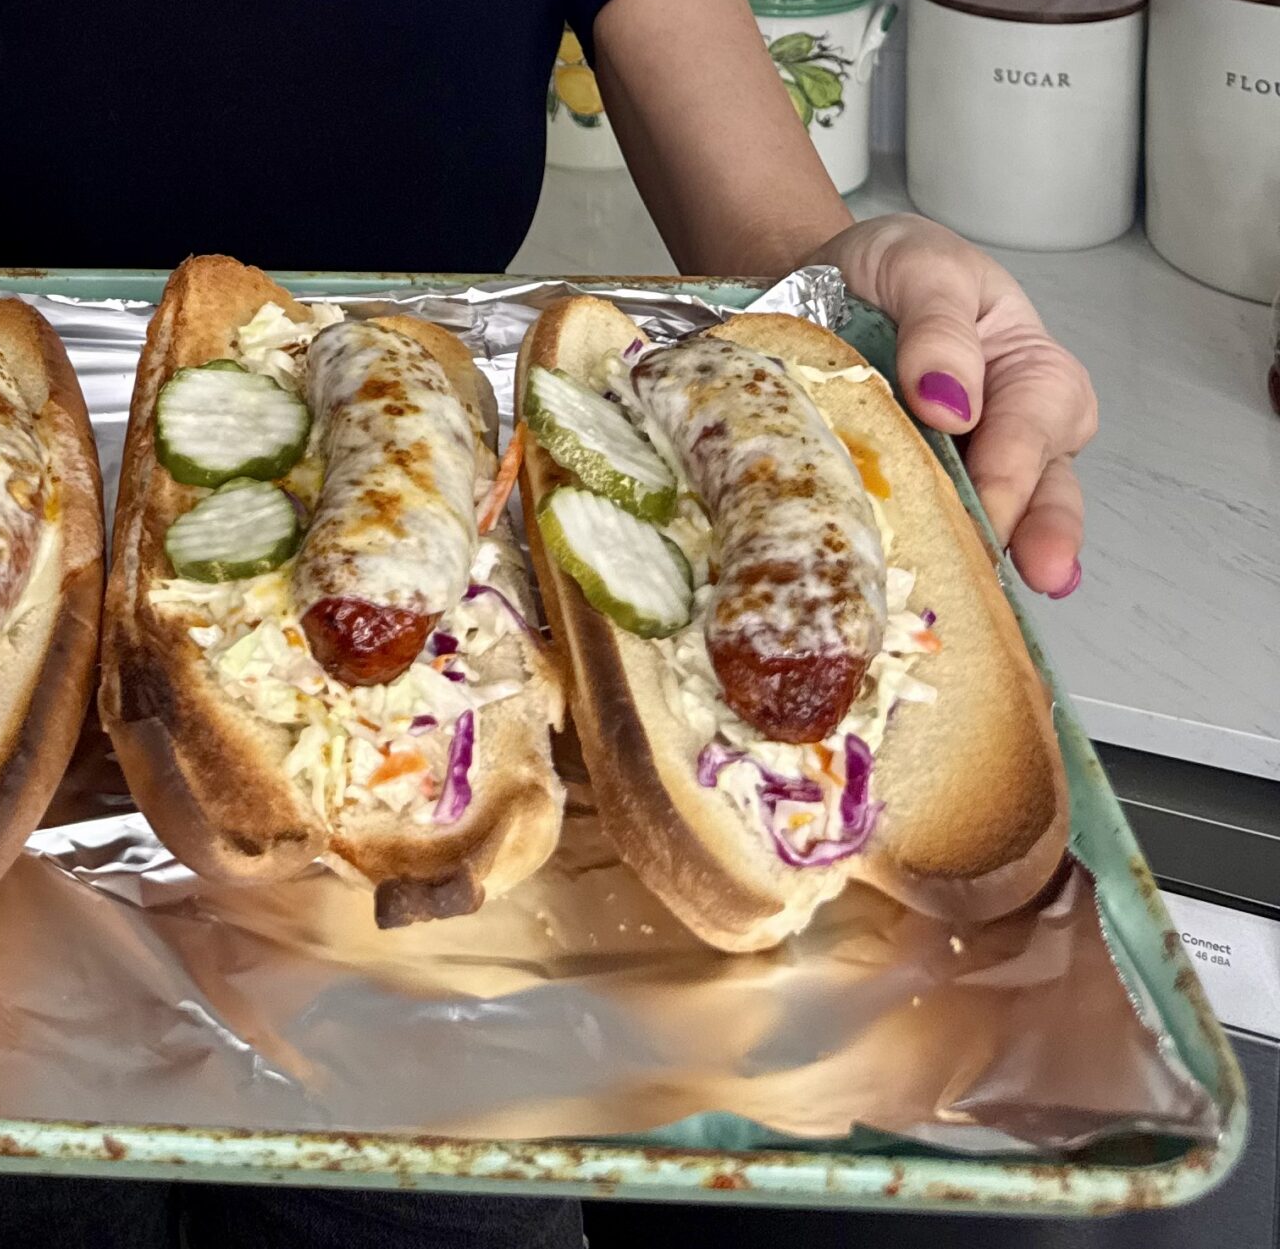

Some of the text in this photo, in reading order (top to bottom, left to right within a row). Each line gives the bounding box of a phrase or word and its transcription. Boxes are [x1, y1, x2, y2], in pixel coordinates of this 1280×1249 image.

[993, 68, 1070, 87] SUGAR
[1181, 932, 1231, 955] Connect
[1195, 951, 1231, 967] 46 dBA
